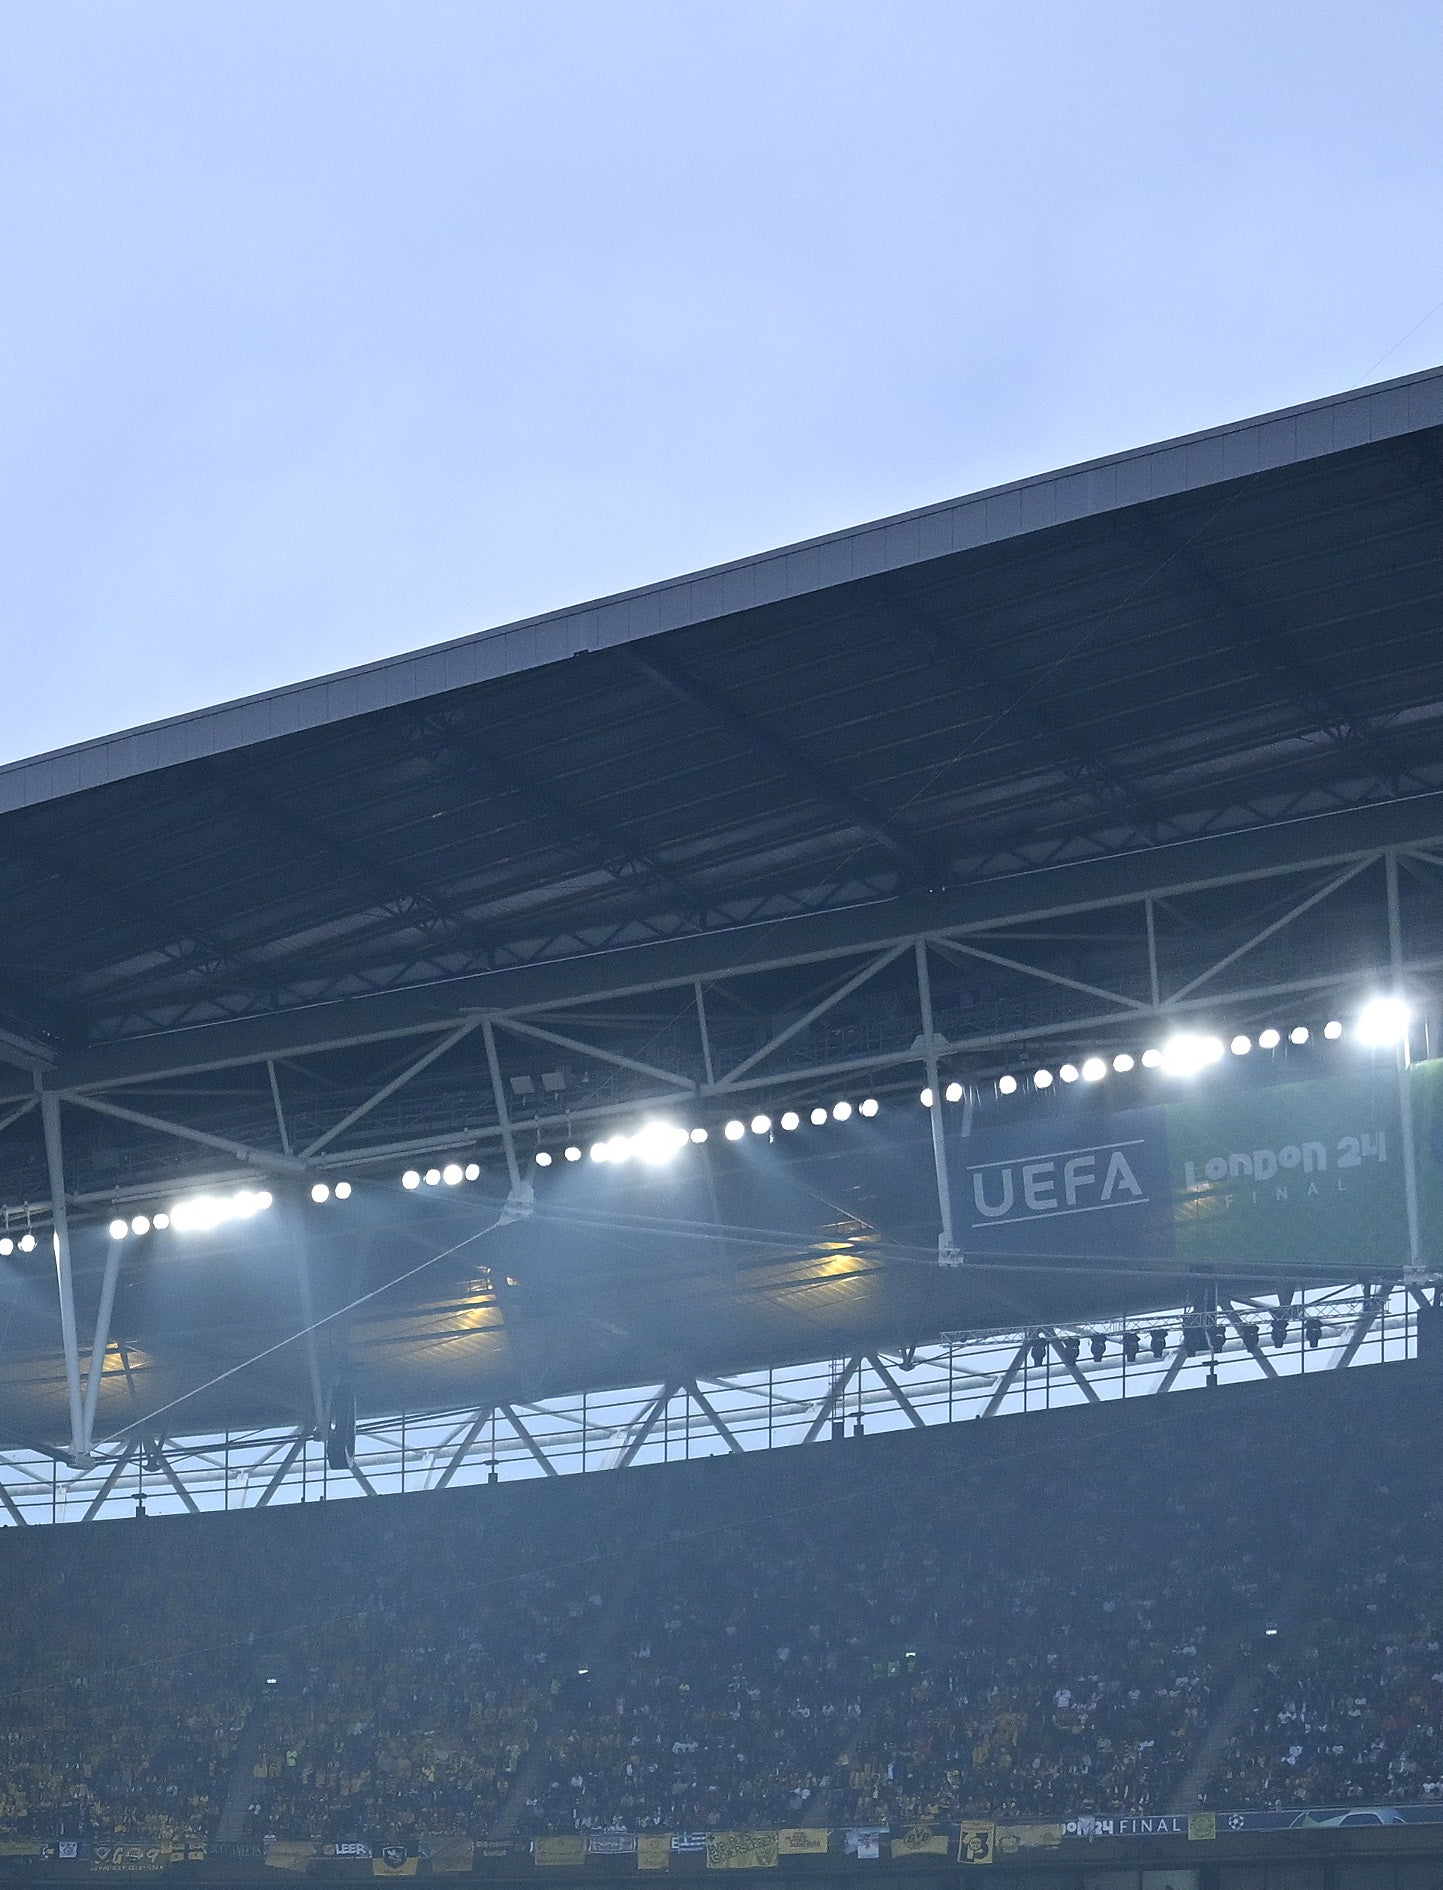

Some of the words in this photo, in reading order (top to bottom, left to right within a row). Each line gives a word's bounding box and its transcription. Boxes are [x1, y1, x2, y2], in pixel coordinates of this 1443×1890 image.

[1183, 1140, 1329, 1189] London
[1335, 1130, 1388, 1170] 24
[973, 1153, 1144, 1218] UEFA
[1225, 1177, 1349, 1211] FINAL
[1096, 1821, 1114, 1835] 24
[1119, 1818, 1181, 1834] FINAL
